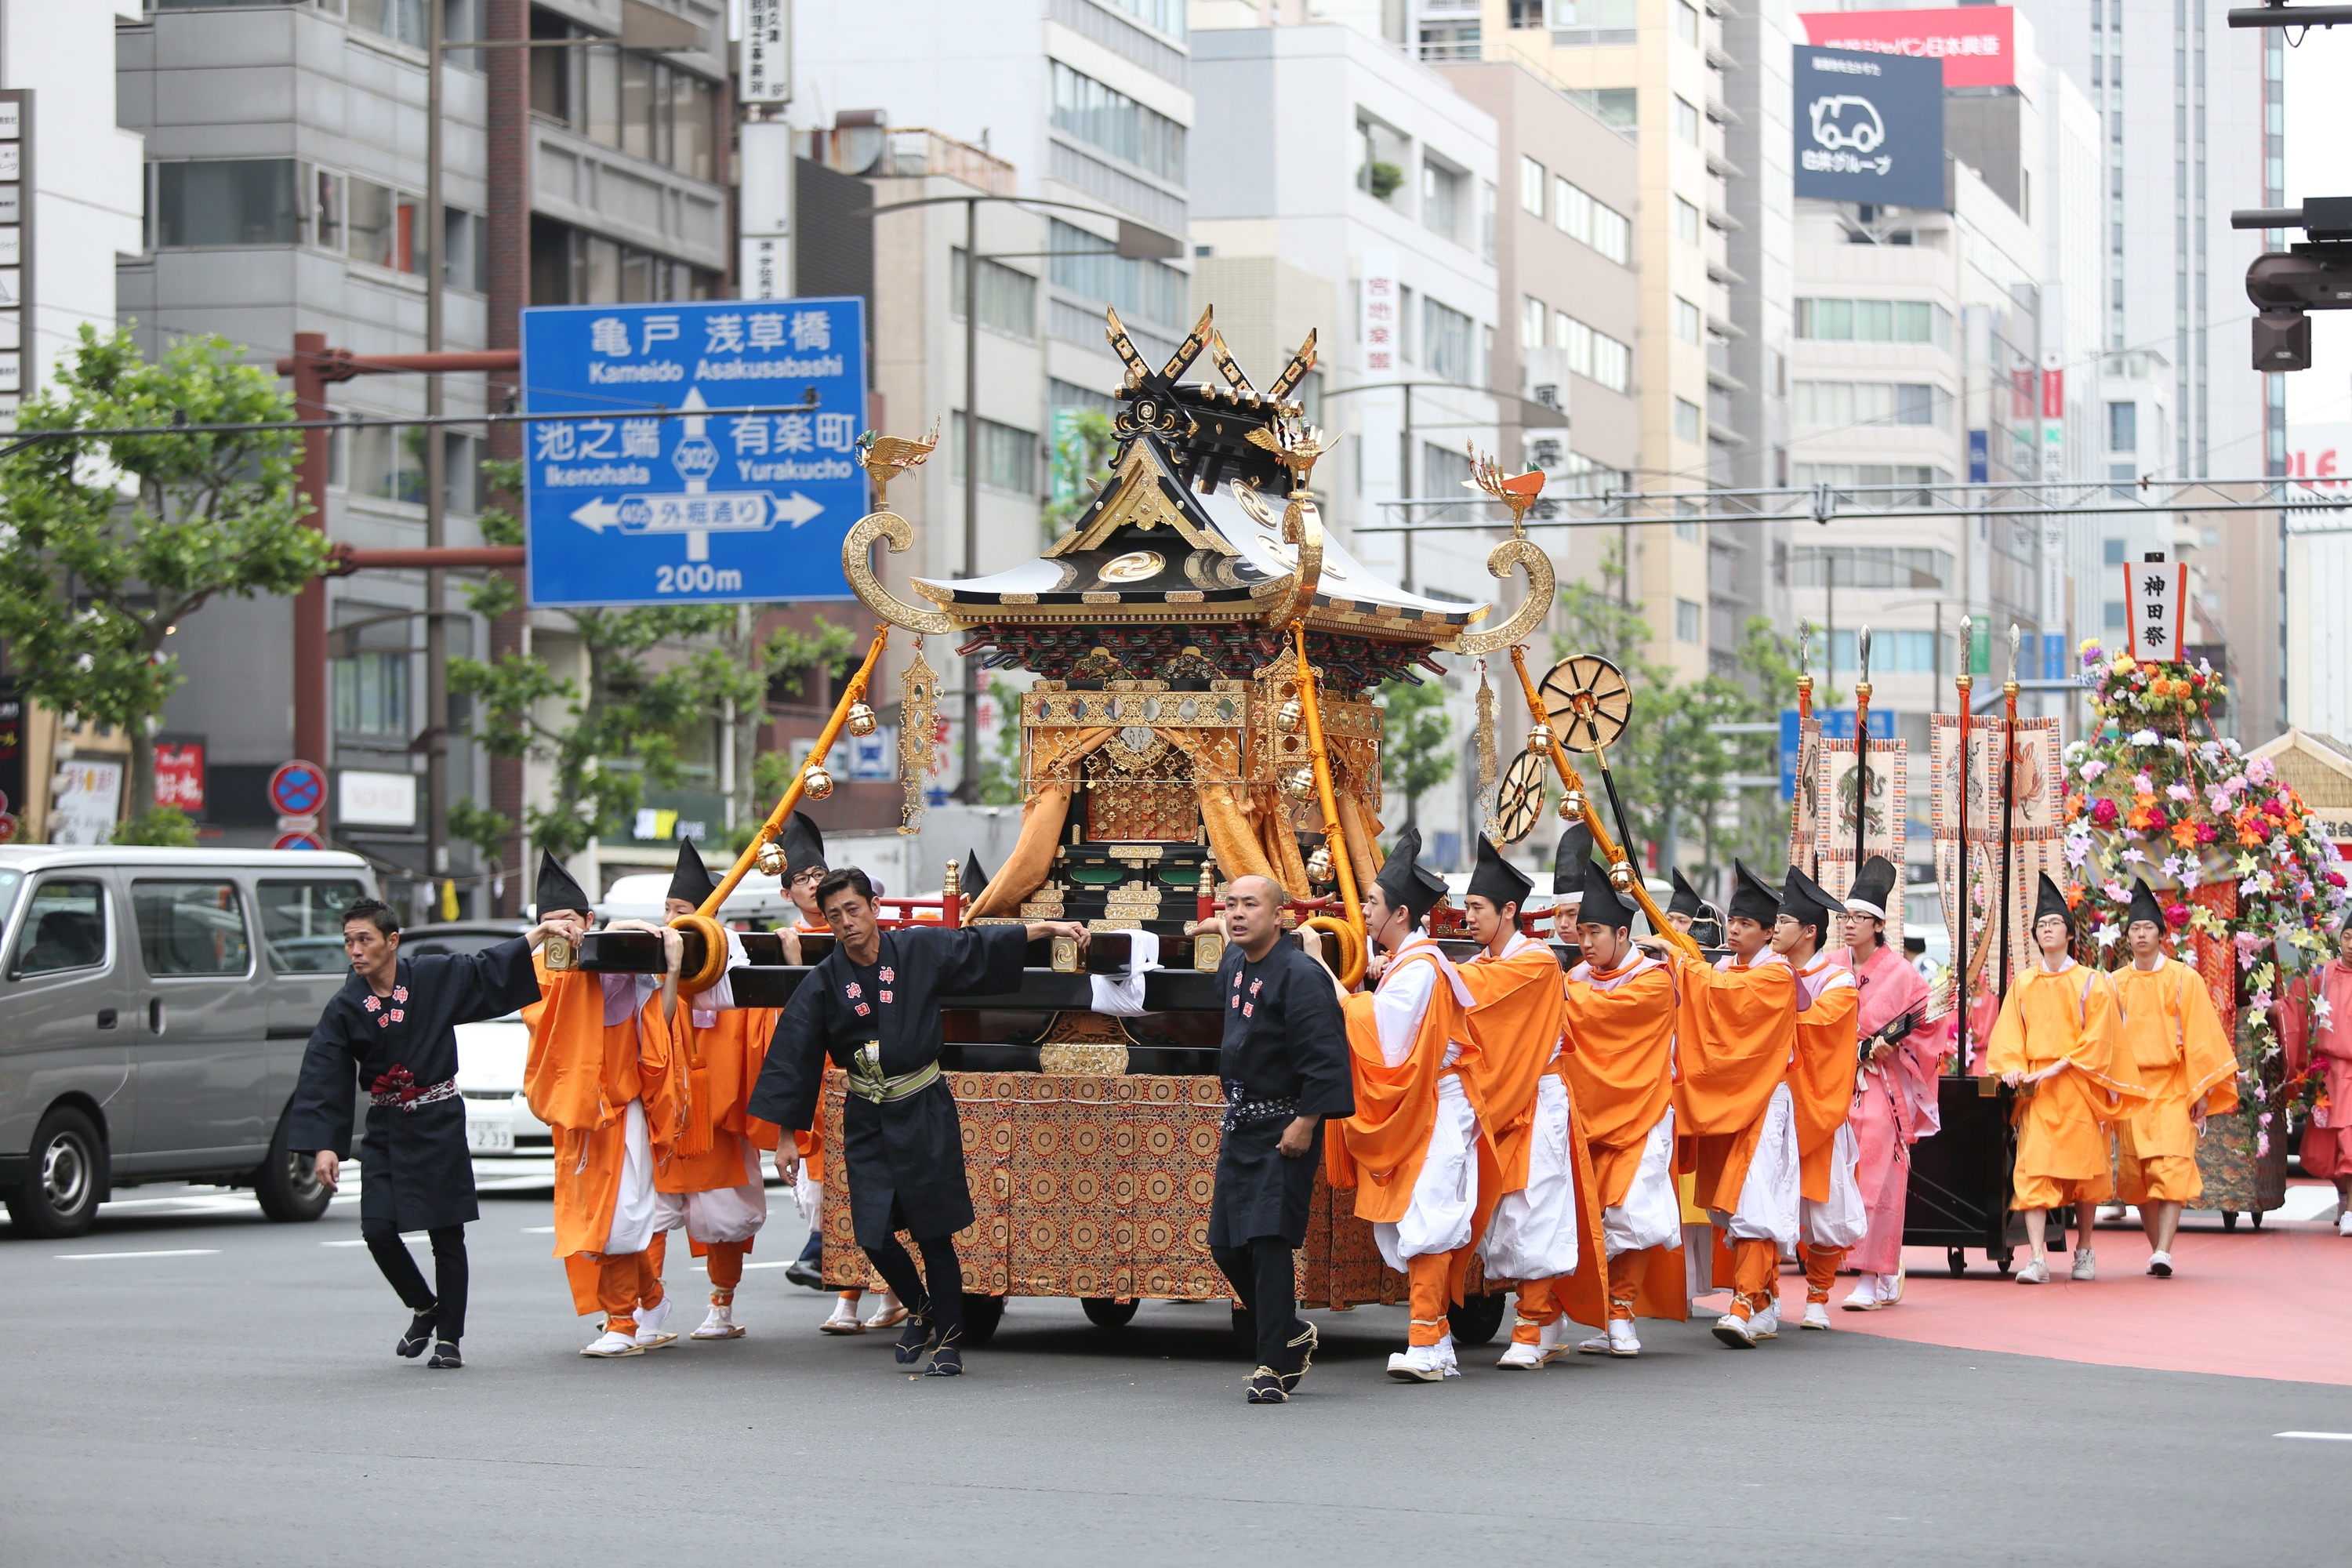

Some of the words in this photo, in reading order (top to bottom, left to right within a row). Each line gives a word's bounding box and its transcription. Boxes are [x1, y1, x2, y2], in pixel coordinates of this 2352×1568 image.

[590, 316, 681, 357] 亀戸
[705, 310, 832, 354] 浅草橋
[589, 360, 684, 384] Kameido
[695, 354, 844, 381] Asakusabashi
[535, 419, 661, 461] 池之端
[729, 413, 856, 455] 有楽町
[546, 464, 650, 486] Ikenohata
[737, 459, 853, 481] Yurakucho
[660, 499, 760, 526] 外堀通り
[655, 564, 742, 593] 200m
[2143, 575, 2167, 647] 神田祭
[846, 982, 871, 1016] 神田
[879, 966, 895, 1004] 神田
[1243, 977, 1263, 1018] 神田
[363, 995, 390, 1029] 神田
[390, 985, 409, 1023] 神田
